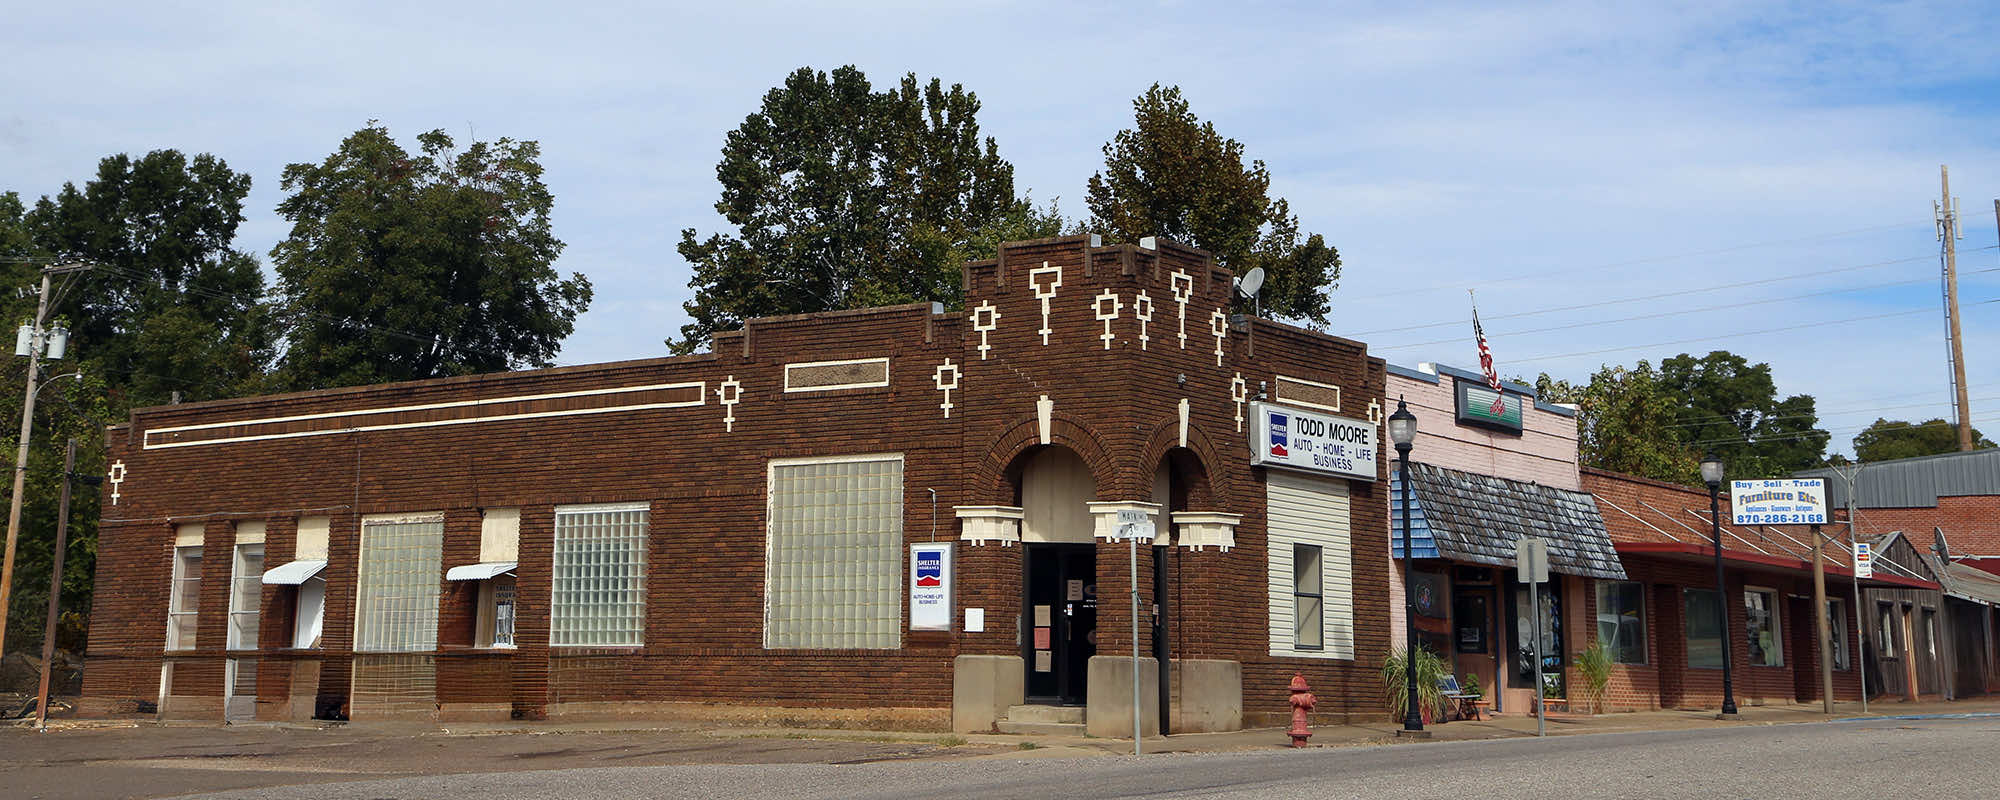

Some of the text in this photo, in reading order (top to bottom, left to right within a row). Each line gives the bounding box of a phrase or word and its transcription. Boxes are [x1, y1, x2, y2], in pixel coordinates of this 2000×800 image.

[1295, 417, 1368, 445] TODD MOORE
[1293, 438, 1312, 452] AUTO
[1323, 443, 1345, 456] HOME
[1355, 448, 1371, 460] LIFE
[1314, 454, 1353, 470] BUSINESS
[1735, 481, 1752, 489] Buy
[1763, 480, 1782, 488] Sell
[1739, 490, 1819, 505] Furniture Etc.
[1121, 512, 1136, 520] MAIN
[1737, 514, 1823, 523] 870-286-2168
